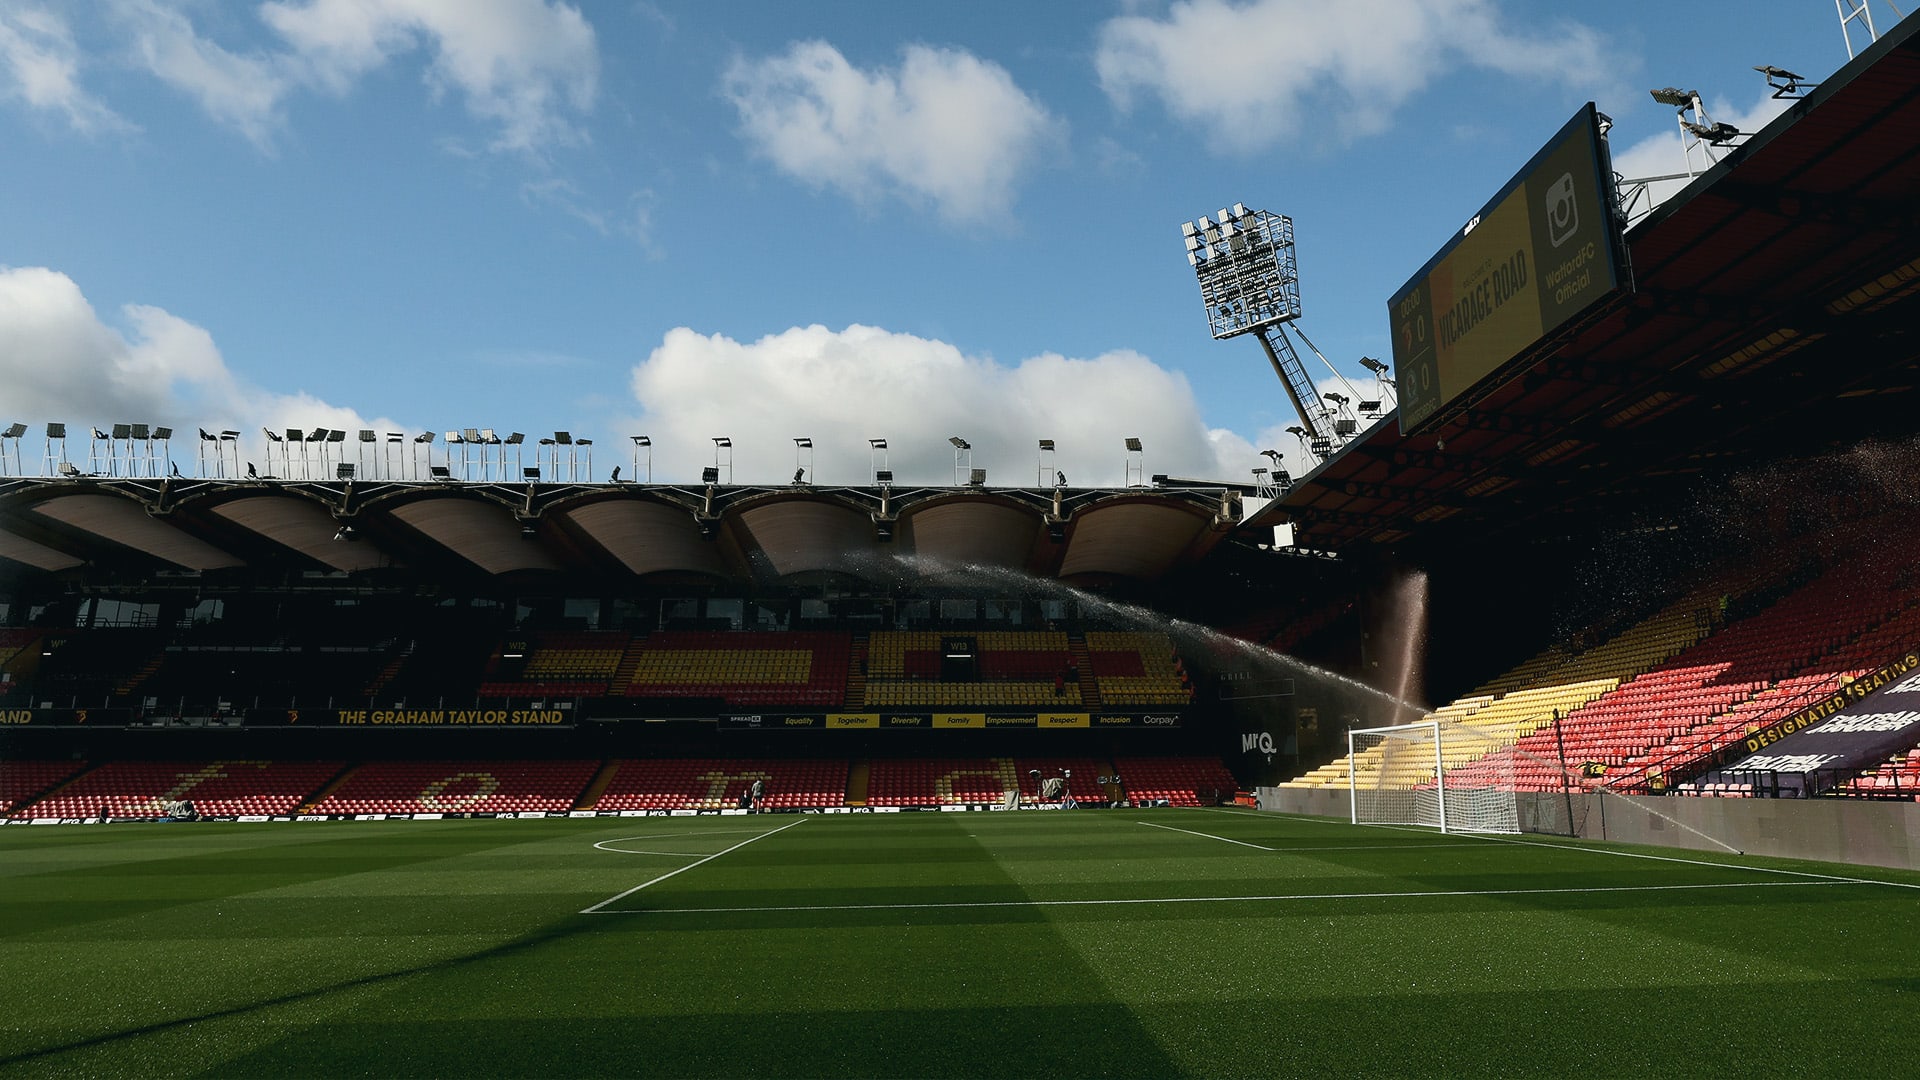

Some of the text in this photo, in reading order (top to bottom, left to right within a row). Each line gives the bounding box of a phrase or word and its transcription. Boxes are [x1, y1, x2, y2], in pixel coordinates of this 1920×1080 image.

[1545, 241, 1595, 289] WatfordFC
[1555, 268, 1591, 305] Official
[1439, 249, 1527, 350] VICARAGE ROAD
[1417, 315, 1425, 342] 0
[1422, 362, 1430, 391] 0
[508, 641, 528, 650] W12
[950, 641, 968, 651] W13
[1746, 696, 1845, 753] DESIGNATED
[1855, 655, 1919, 697] SEATING
[338, 710, 563, 724] THE GRAHAM TAYLOR STAND
[785, 717, 814, 726] Equality
[838, 716, 868, 725] Together
[891, 716, 921, 725] Diversity
[947, 716, 971, 725] Family
[986, 716, 1037, 725] Empowerment
[1049, 716, 1078, 725] Respect
[1100, 715, 1131, 724] Inclusion
[1241, 731, 1277, 754] MrQ
